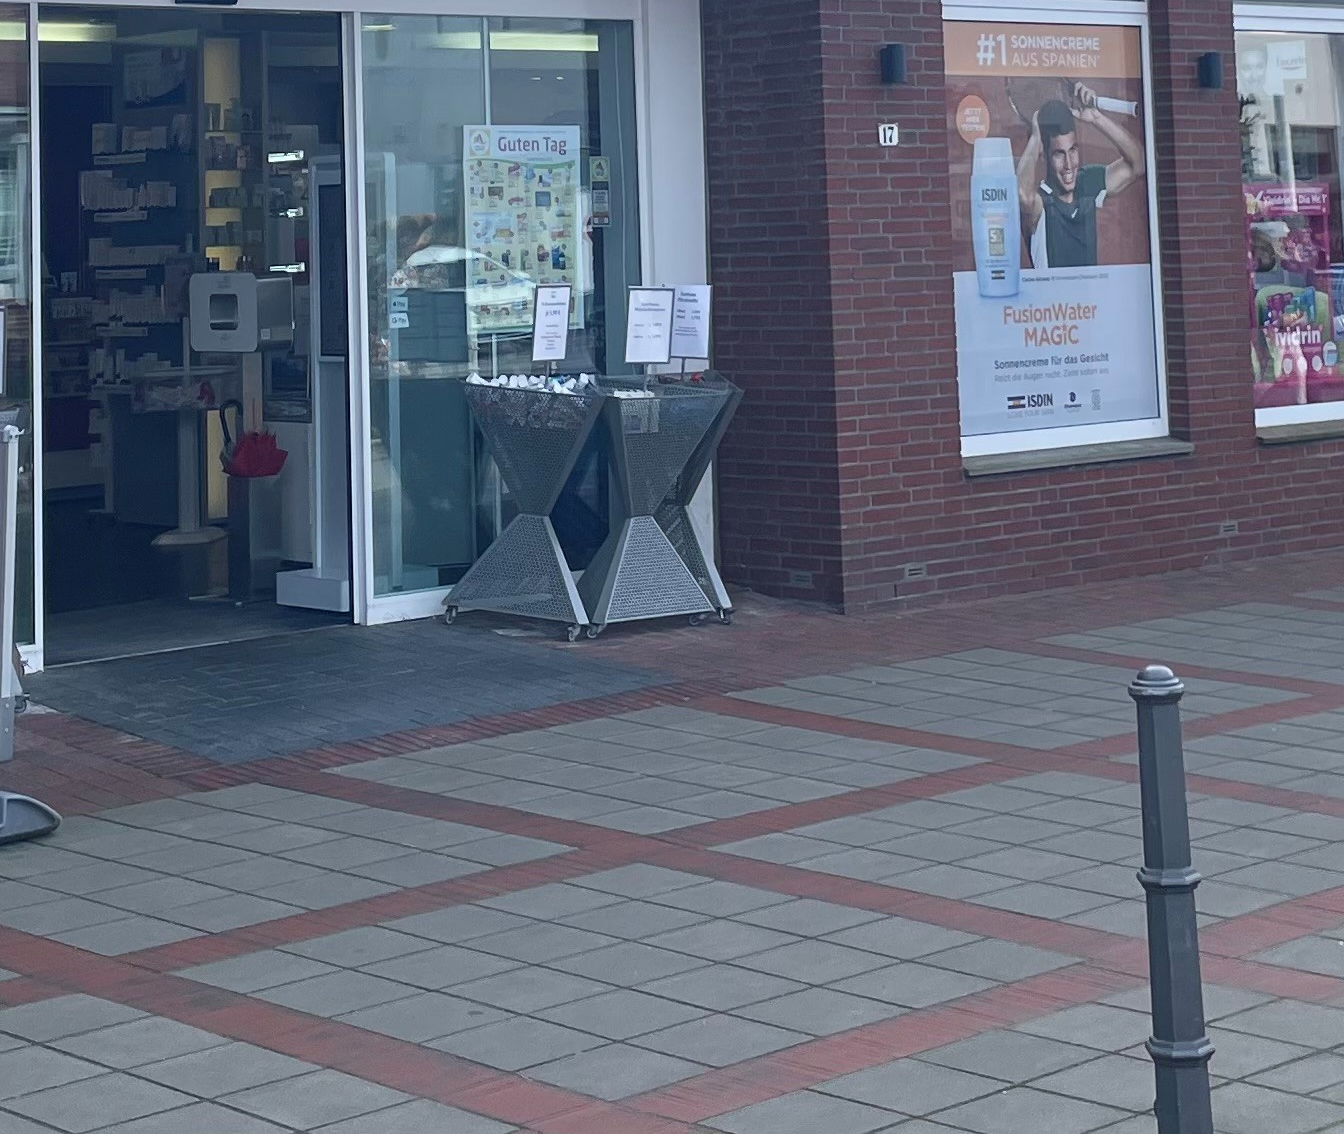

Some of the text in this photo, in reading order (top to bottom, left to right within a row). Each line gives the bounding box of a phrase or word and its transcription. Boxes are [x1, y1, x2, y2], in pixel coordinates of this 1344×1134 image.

[976, 33, 1100, 66] #1 SONNENCREME
[1012, 52, 1038, 66] AUS
[882, 126, 894, 144] 17
[498, 136, 567, 155] Guten Tag
[982, 188, 1007, 201] ISDIN
[1003, 303, 1097, 324] FusionWater
[994, 352, 1109, 369] Sonnencreme für das Gesicht
[1027, 393, 1053, 407] ISDIN
